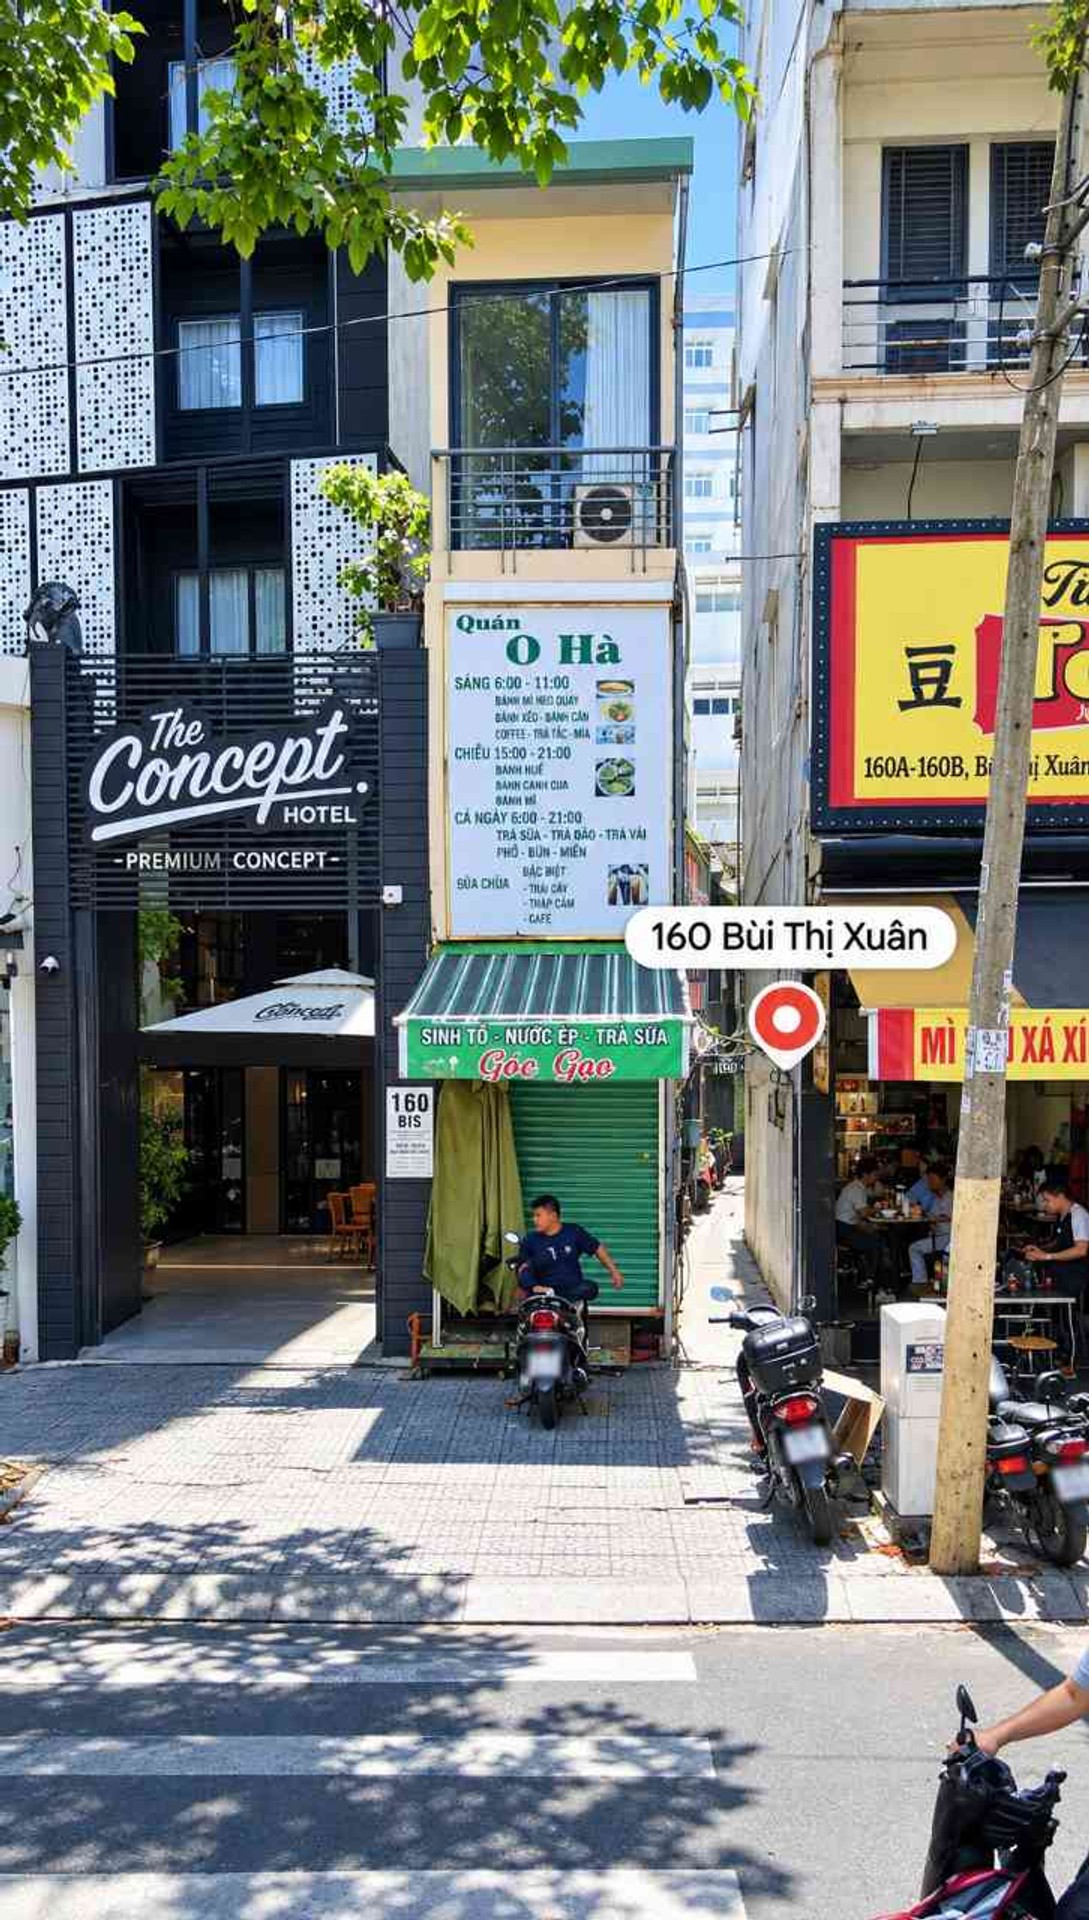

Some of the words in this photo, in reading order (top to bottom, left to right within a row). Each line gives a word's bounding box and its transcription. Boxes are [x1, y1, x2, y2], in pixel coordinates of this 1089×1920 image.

[456, 614, 520, 634] Quán
[506, 634, 541, 665] O
[558, 634, 622, 665] Hà
[454, 673, 490, 690] SÁNG
[494, 676, 522, 690] 6:00
[534, 675, 570, 690] 11:00
[897, 644, 962, 712] 豆
[150, 708, 205, 751] The
[494, 747, 527, 760] 15:00
[538, 747, 571, 760] 21:00
[864, 756, 969, 780] 160A-160B,
[284, 806, 356, 824] HOTEL
[511, 811, 537, 824] 6:00
[548, 811, 582, 824] 21:00
[421, 1028, 460, 1045] SINH
[505, 1024, 552, 1045] NƯỚC
[596, 1025, 628, 1045] TRÀ
[921, 1017, 955, 1064] MÌ
[1021, 1016, 1054, 1063] XÁ
[391, 1093, 428, 1112] 160
[398, 1115, 421, 1128] BIS
